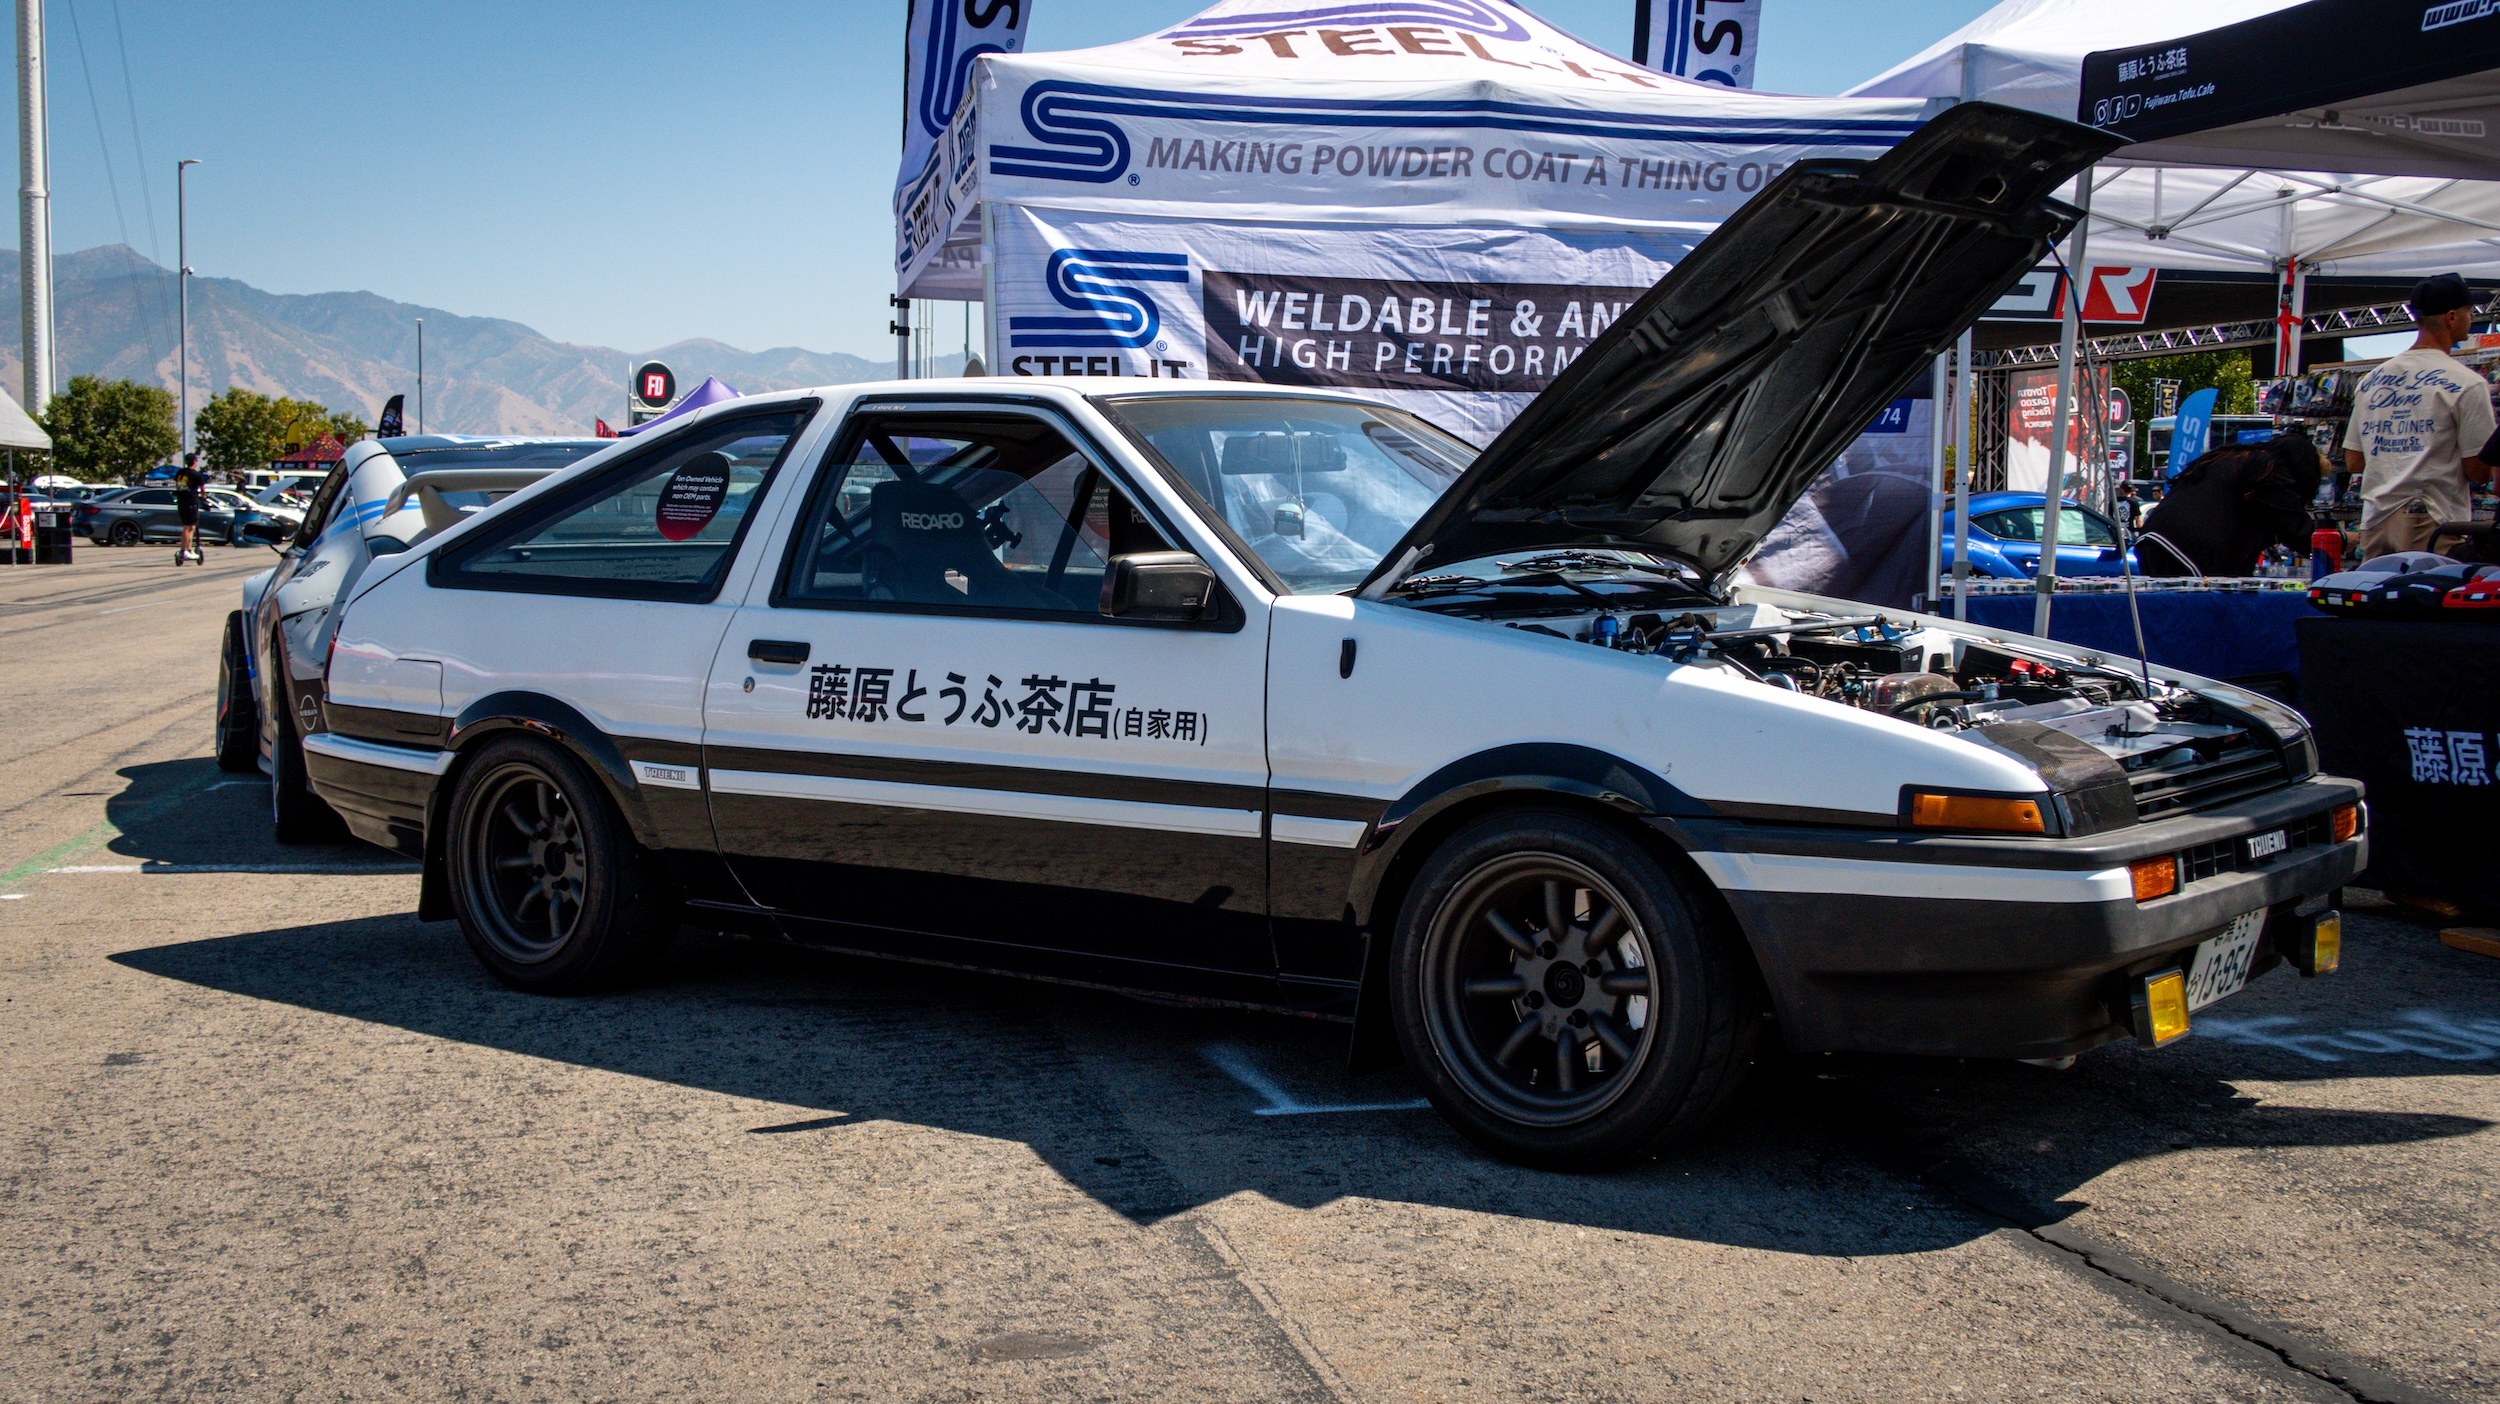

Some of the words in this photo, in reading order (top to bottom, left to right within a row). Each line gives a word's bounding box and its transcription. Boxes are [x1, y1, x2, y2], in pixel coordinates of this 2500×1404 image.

[1171, 27, 1662, 89] STEEL-IT
[2117, 47, 2188, 83] 藤原とうふ茶店
[1147, 136, 1303, 175] MAKING
[1311, 144, 1474, 178] POWDER
[1483, 148, 1579, 183] COAT
[1583, 155, 1607, 186] A
[1619, 157, 1730, 192] THING
[1236, 289, 1492, 337] WELDABLE
[1510, 299, 1544, 338] &
[1555, 301, 1634, 339] AN
[1238, 335, 1352, 371] HIGH
[647, 375, 664, 396] FD
[2368, 387, 2423, 410] Dore
[2398, 419, 2436, 434] DINER
[686, 475, 705, 483] Owned
[901, 511, 964, 530] RECARO
[299, 709, 318, 717] NISSAN
[2404, 726, 2500, 786] 藤原
[644, 766, 686, 781] TRUENO
[2247, 829, 2287, 859] TRUENO
